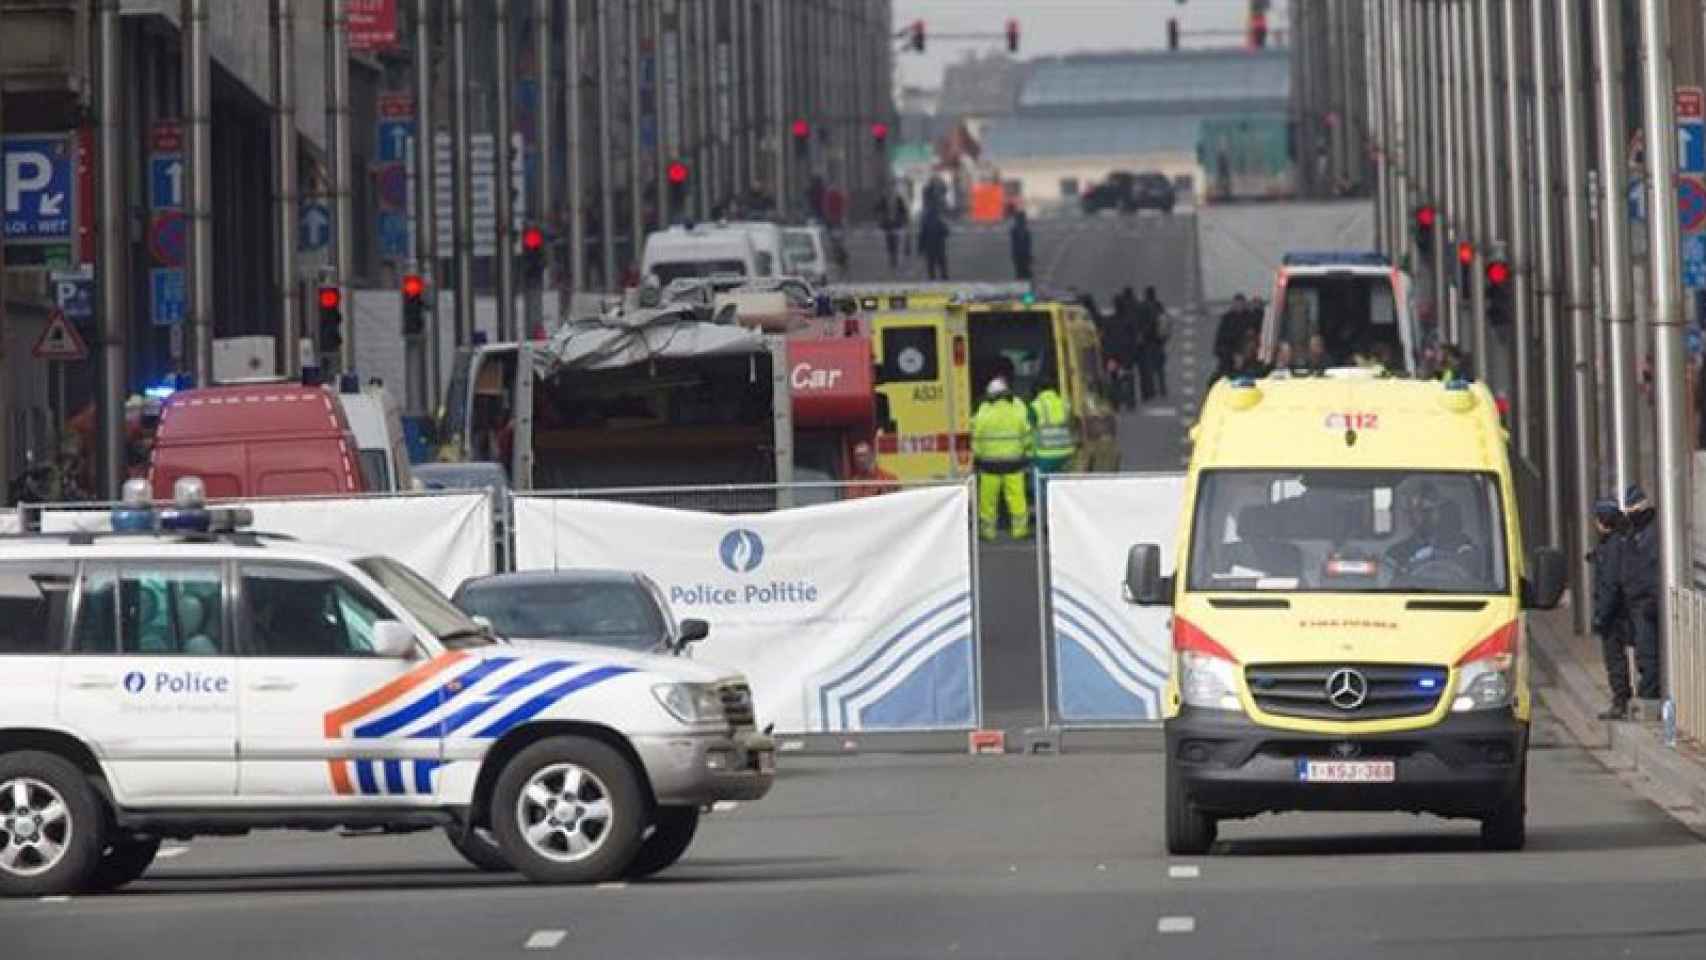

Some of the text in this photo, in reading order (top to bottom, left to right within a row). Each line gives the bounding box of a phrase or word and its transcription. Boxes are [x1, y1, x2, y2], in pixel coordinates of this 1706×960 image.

[5, 152, 53, 212] P
[57, 282, 77, 306] P
[791, 362, 842, 389] Car
[1345, 413, 1379, 429] 112
[671, 580, 818, 605] Police Politie
[155, 670, 230, 693] Police
